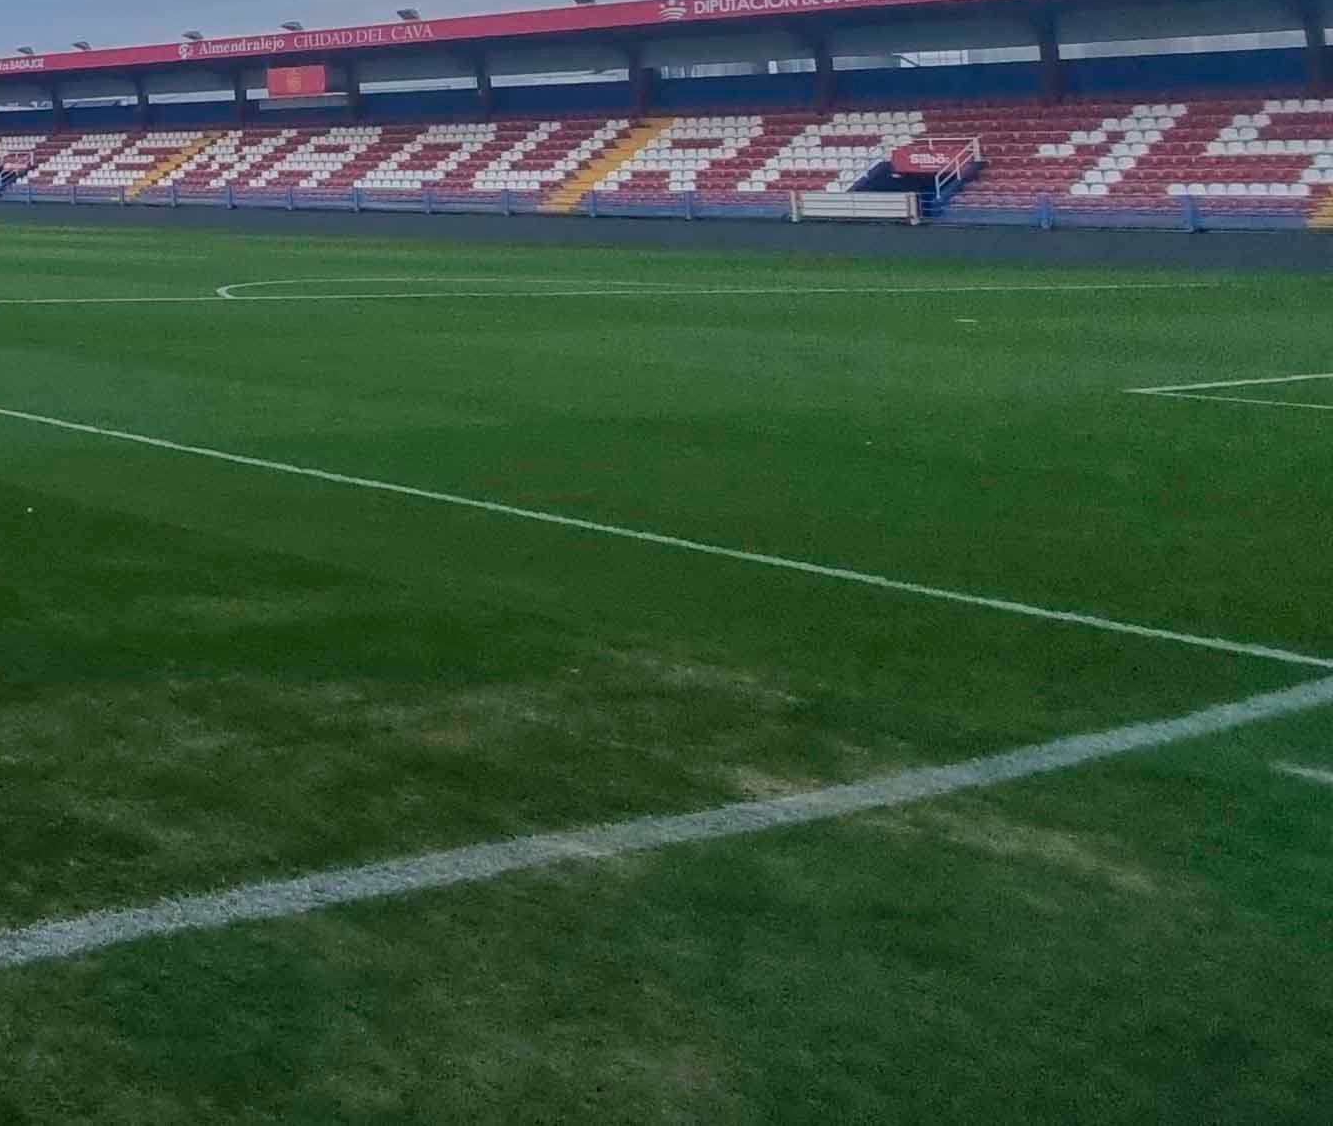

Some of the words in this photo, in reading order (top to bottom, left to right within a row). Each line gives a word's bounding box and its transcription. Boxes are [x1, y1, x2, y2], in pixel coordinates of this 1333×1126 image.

[199, 36, 285, 55] Almendralejo
[293, 31, 353, 49] CIUDAD
[356, 28, 386, 44] DEL
[391, 24, 434, 40] CAVA
